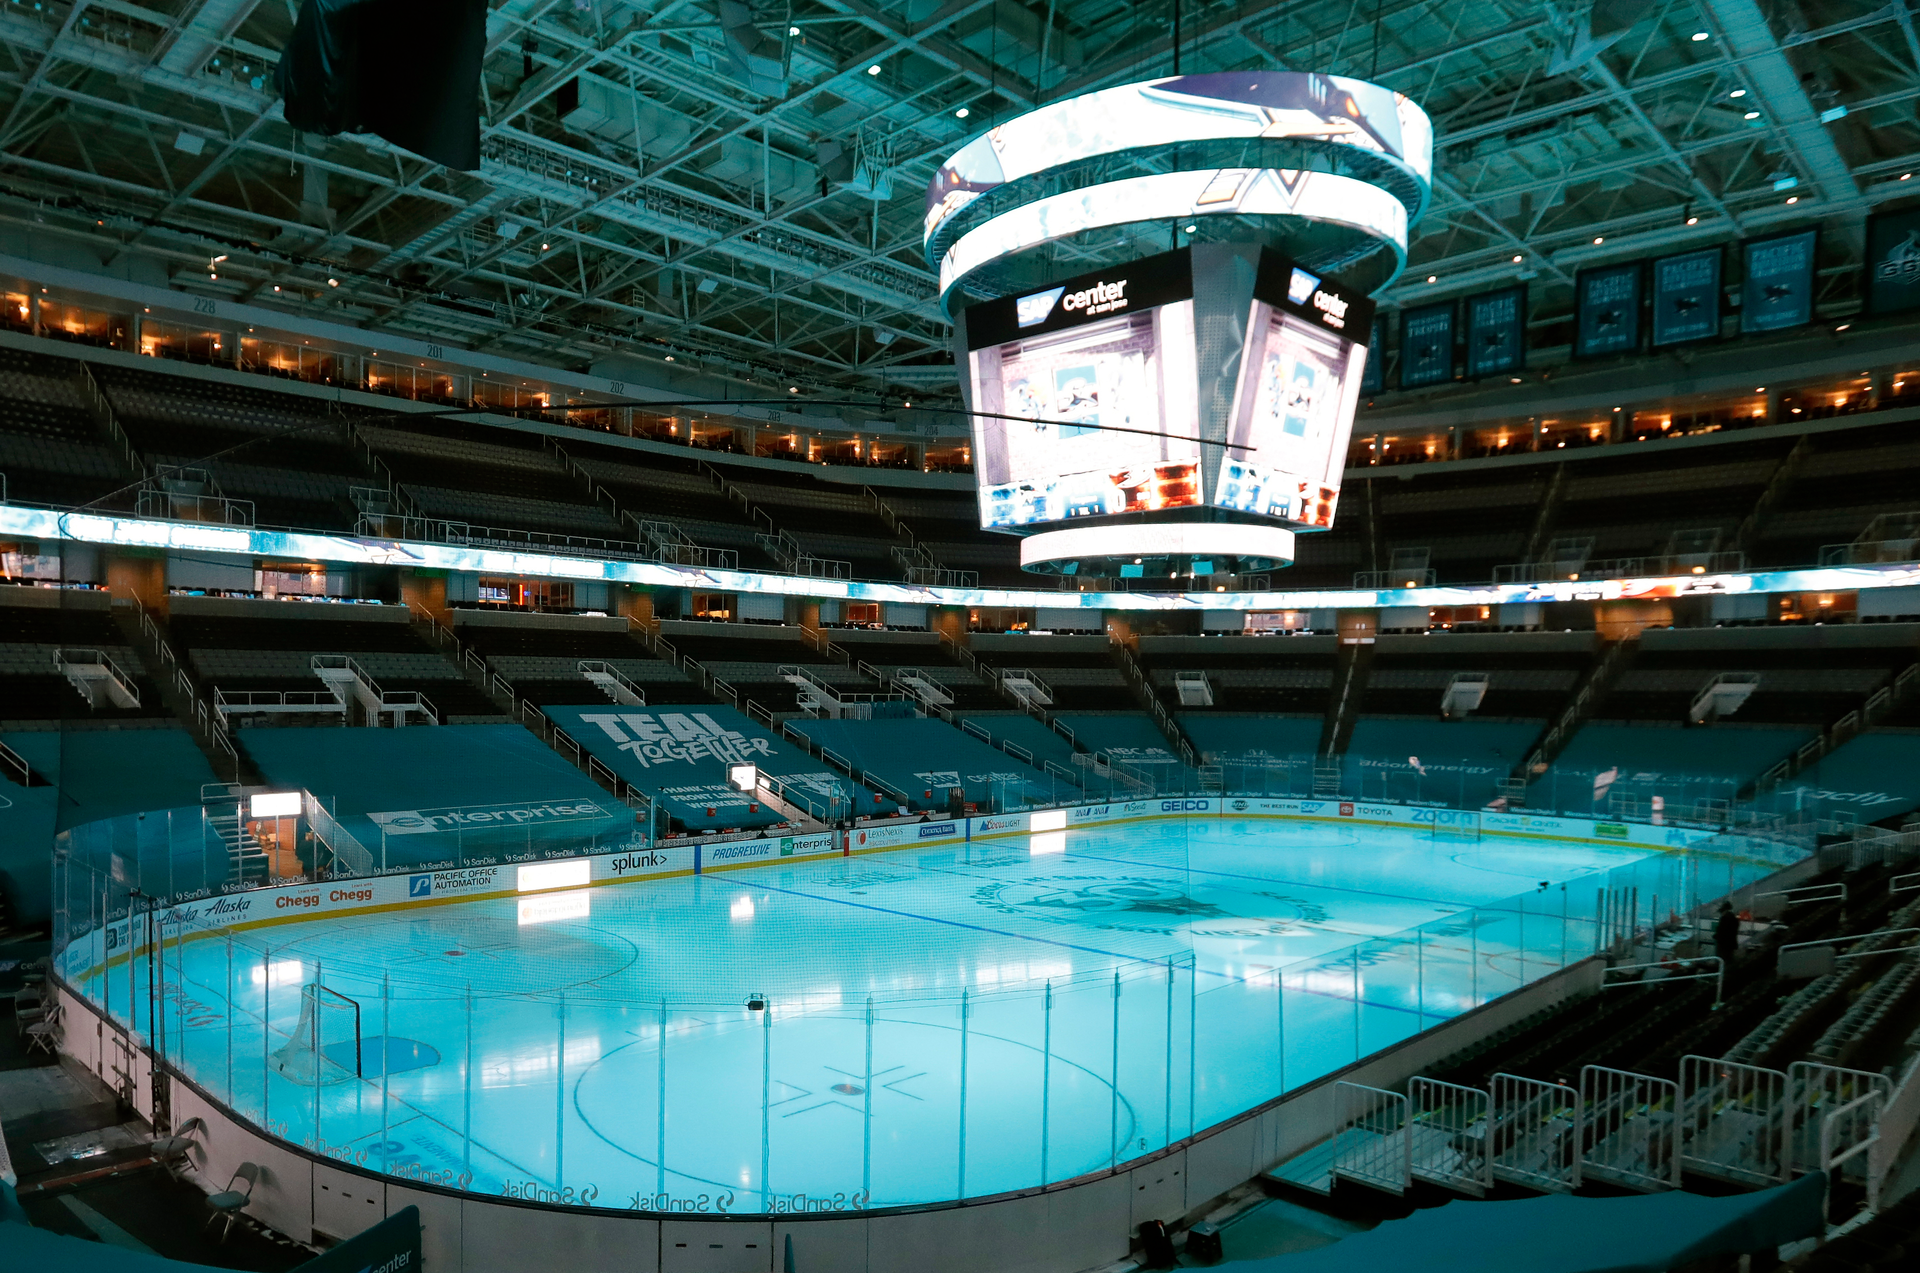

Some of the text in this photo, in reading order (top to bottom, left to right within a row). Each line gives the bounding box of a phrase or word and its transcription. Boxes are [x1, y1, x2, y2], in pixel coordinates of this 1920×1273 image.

[194, 298, 216, 315] 228
[1017, 279, 1128, 322] SAP center
[427, 344, 443, 360] 201
[610, 381, 625, 395] 202
[768, 410, 781, 422] 203
[578, 713, 748, 742] TEAL
[617, 734, 778, 768] TOGETHER
[670, 793, 712, 801] FRONT
[1161, 800, 1209, 812] GEICO
[1301, 803, 1320, 812] SAP
[1358, 807, 1393, 816] TOYOTA
[390, 804, 601, 827] enterprise
[1005, 820, 1020, 828] LIGHT
[868, 828, 903, 839] LexisNexis
[782, 838, 832, 851] enterpris
[552, 849, 576, 858] SanDisk
[712, 843, 772, 860] PROGRESSIVE
[427, 861, 455, 869] SanDisk
[471, 857, 497, 866] SanDisk
[278, 875, 308, 885] SanDisk
[434, 867, 498, 881] PACIFIC OFFICE
[229, 881, 259, 892] SanDisk
[434, 877, 491, 890] AUTOMATION
[275, 895, 320, 909] Chegg
[329, 889, 372, 902] Chegg
[205, 897, 252, 917] Alaska
[207, 913, 247, 927] AIRLINES
